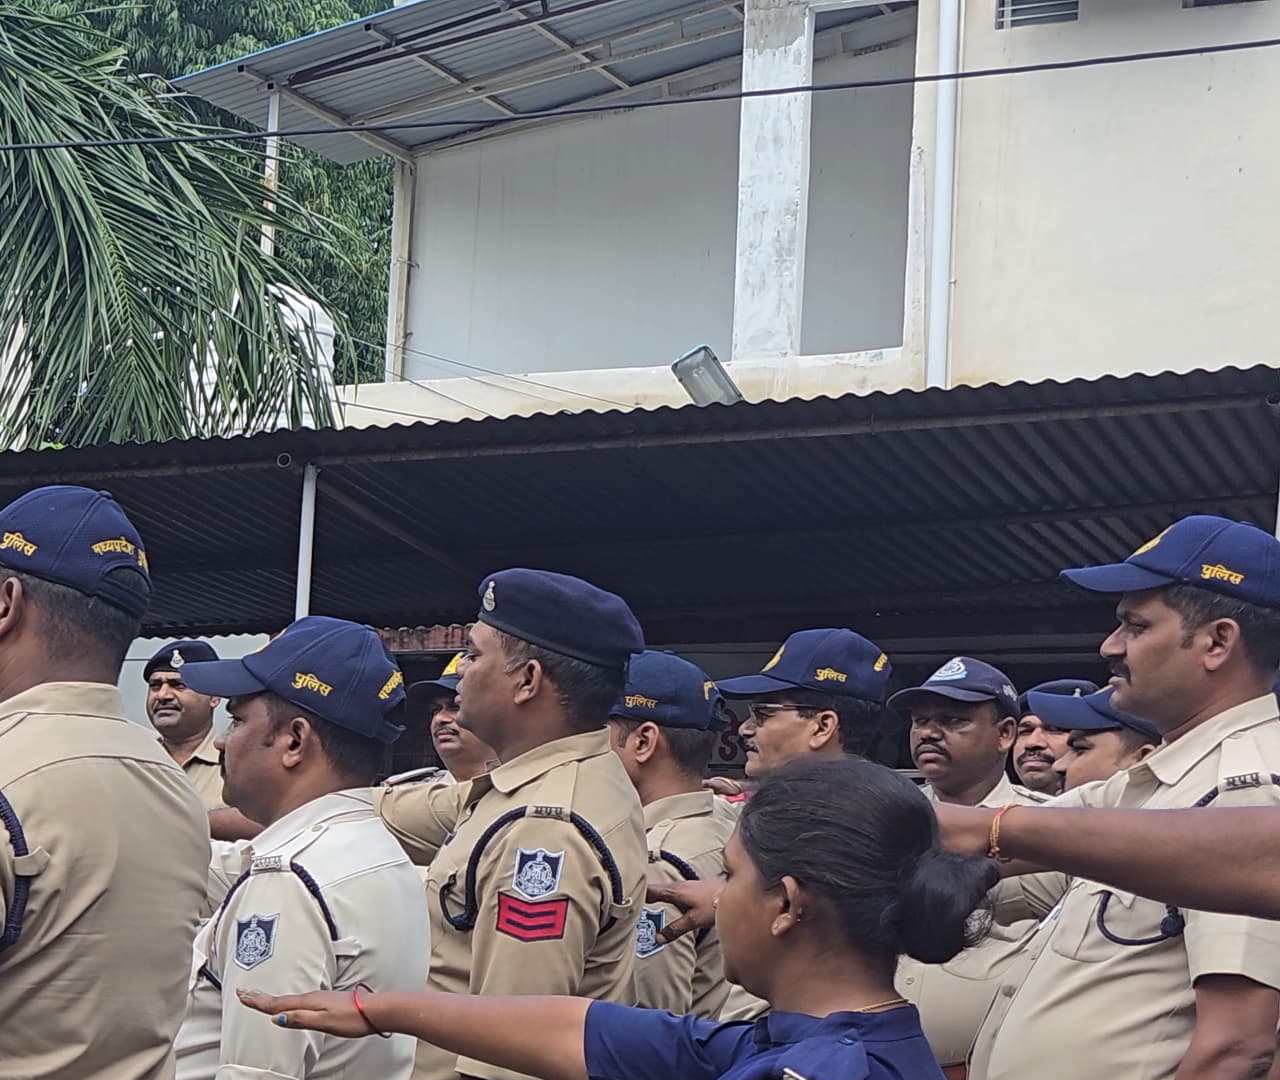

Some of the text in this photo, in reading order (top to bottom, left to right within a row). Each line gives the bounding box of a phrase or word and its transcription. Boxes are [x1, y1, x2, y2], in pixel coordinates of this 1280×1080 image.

[1200, 563, 1245, 585] पुलिस
[291, 671, 334, 697] पुलिस
[814, 667, 849, 683] पुलिस
[624, 694, 660, 709] पुलिस
